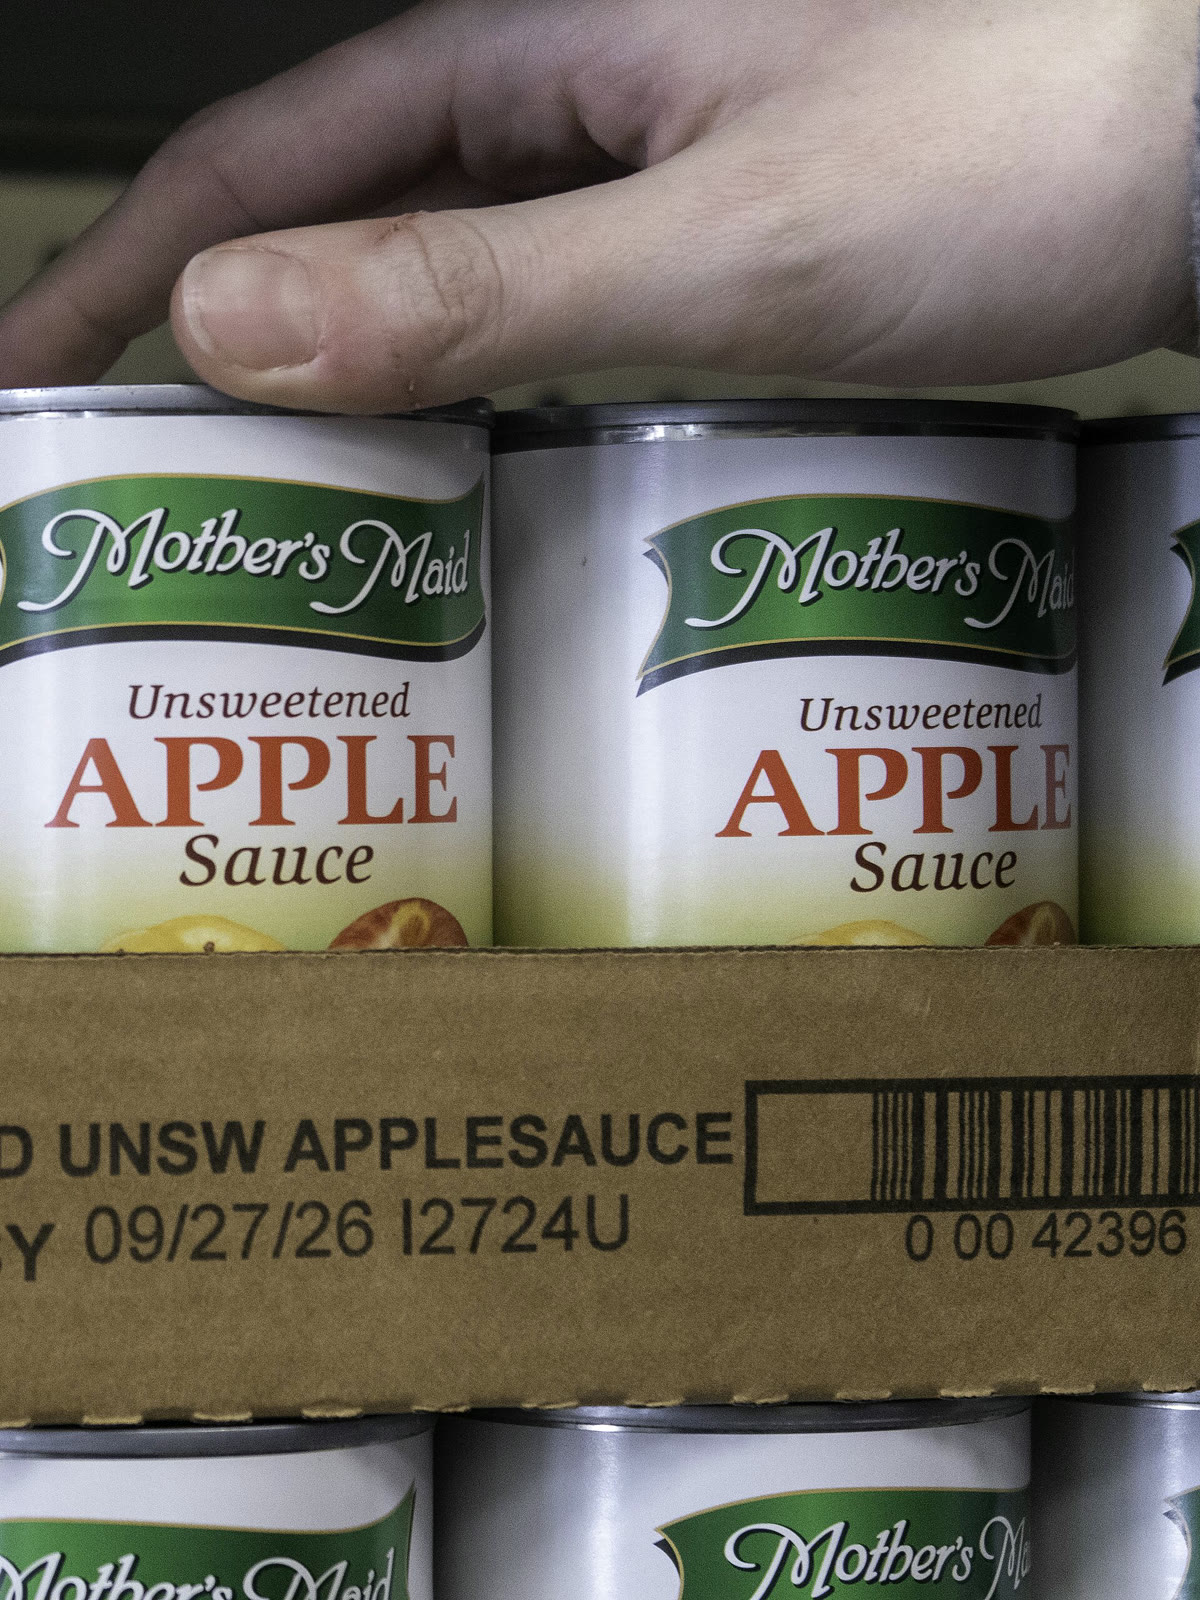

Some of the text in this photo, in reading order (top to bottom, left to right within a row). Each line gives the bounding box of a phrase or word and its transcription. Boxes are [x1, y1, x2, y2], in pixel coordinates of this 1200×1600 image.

[17, 507, 470, 614] Mother's Maid
[685, 527, 1074, 629] Mother's Maid
[127, 681, 411, 720] Unsweetened
[800, 693, 1043, 732] Unsweetened
[44, 734, 458, 828] APPLE
[715, 744, 1072, 838] APPLE
[179, 833, 374, 887] Sauce
[850, 841, 1017, 893] Sauce
[58, 1119, 266, 1178] UNSW
[283, 1111, 735, 1174] APPLESAUCE
[84, 1199, 375, 1265] 09/27/26
[905, 1209, 1187, 1262] 0 00 42396
[724, 1519, 974, 1600] Mother's
